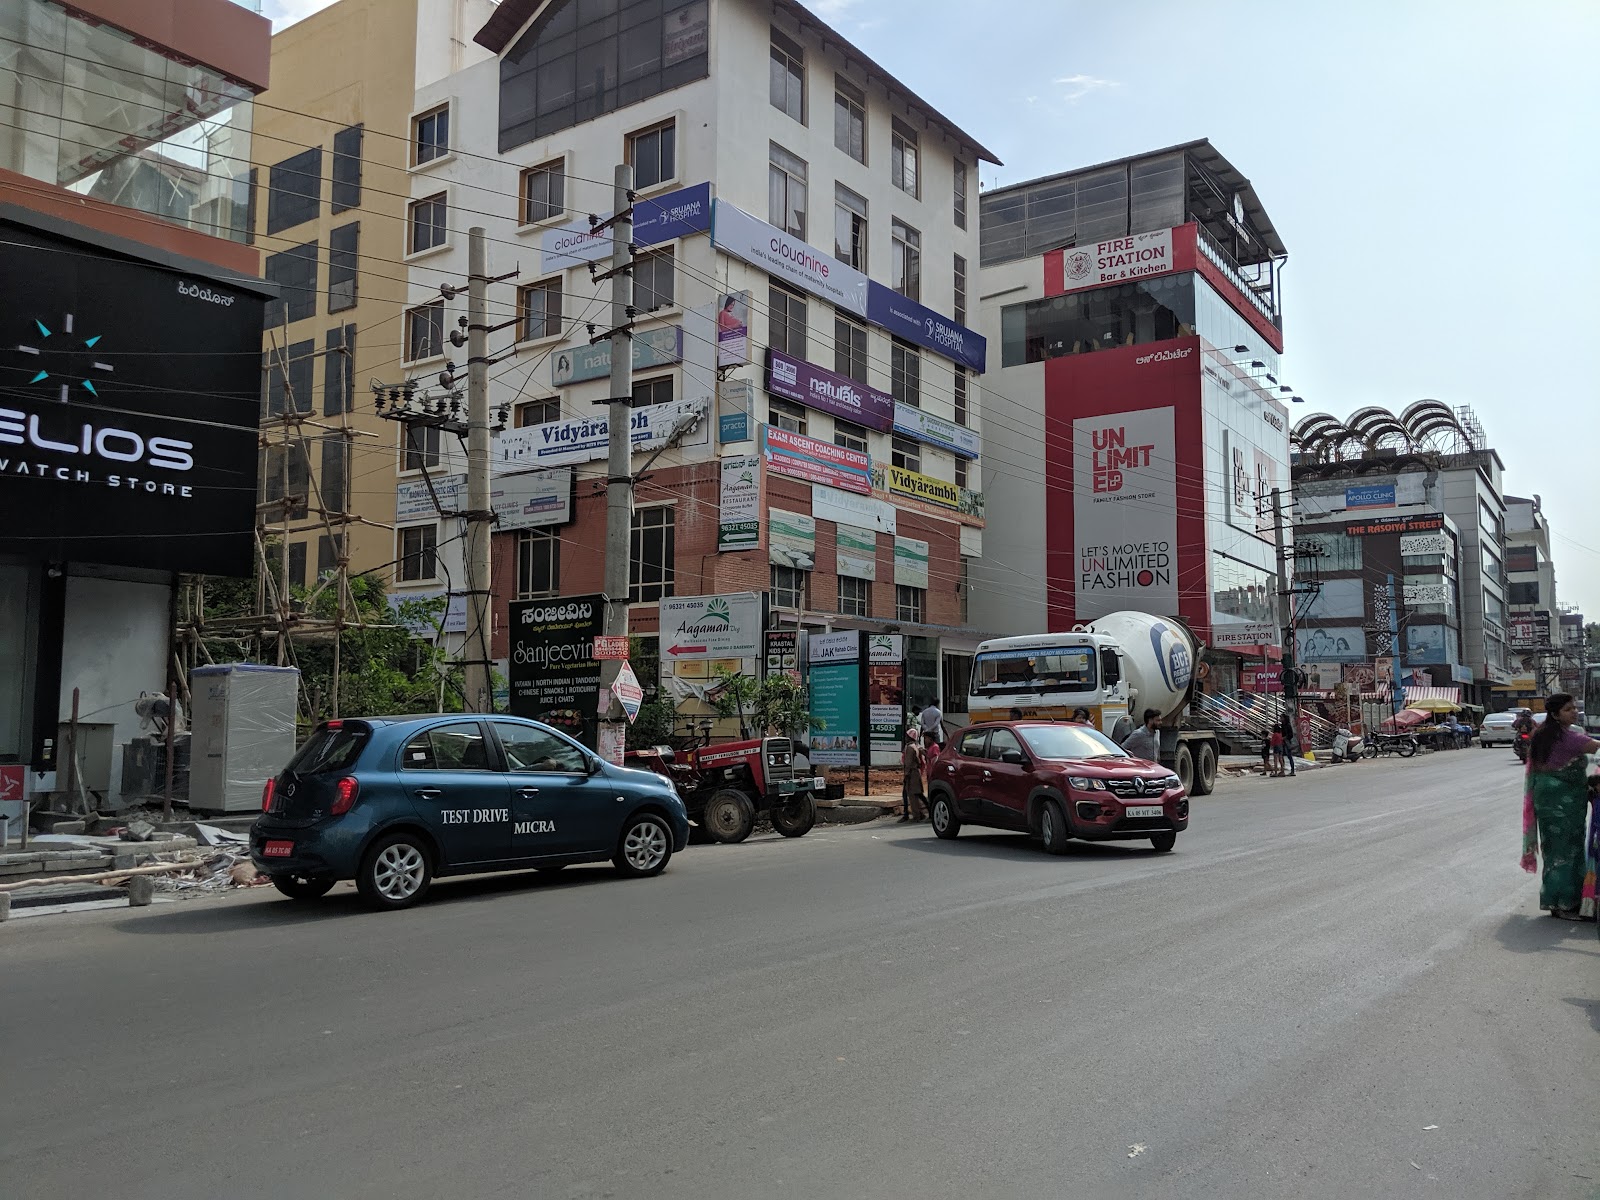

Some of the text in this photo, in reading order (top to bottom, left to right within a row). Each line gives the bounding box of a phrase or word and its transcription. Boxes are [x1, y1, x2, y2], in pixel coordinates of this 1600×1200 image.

[669, 209, 701, 223] HOSPITAL
[671, 201, 701, 215] SRUJANA
[1097, 237, 1134, 256] FIRE
[770, 238, 829, 278] cloudnine
[1097, 246, 1166, 270] STATION
[1100, 263, 1167, 282] Bar & Kitchen
[935, 321, 964, 345] SRUJANA
[934, 331, 963, 354] HOSPITAL
[809, 377, 861, 408] naturals
[1092, 426, 1125, 450] UN
[768, 429, 788, 444] EXAM
[789, 436, 815, 450] ASCENT
[815, 443, 845, 459] COACHING
[845, 452, 868, 466] CENTER
[1092, 445, 1155, 472] LIMIT
[108, 475, 193, 498] STORE
[1093, 469, 1123, 494] ED
[722, 496, 757, 504] RESTAURANT
[1093, 492, 1156, 504] FAMILY FASHION STORE
[1348, 491, 1394, 501] APOLLO CLINIC
[740, 522, 758, 530] 45035
[1347, 520, 1443, 535] THE RASOIYA STREET
[1081, 541, 1169, 558] LET'S MOVE TO
[1082, 553, 1170, 573] UNLIMITED
[1082, 569, 1170, 590] FASHION
[675, 620, 729, 638] Aagaman
[1217, 632, 1273, 642] FIRE STATION
[513, 636, 594, 669] Sanjeevin
[594, 640, 608, 648] PG
[821, 648, 835, 658] JAK
[535, 679, 553, 687] NORTH
[553, 678, 571, 686] INDIAN
[544, 687, 565, 695] SNACKS
[558, 695, 575, 703] CHATS
[876, 724, 897, 732] 45035
[440, 808, 510, 825] TEST DRIVE
[513, 820, 556, 835] MICRA
